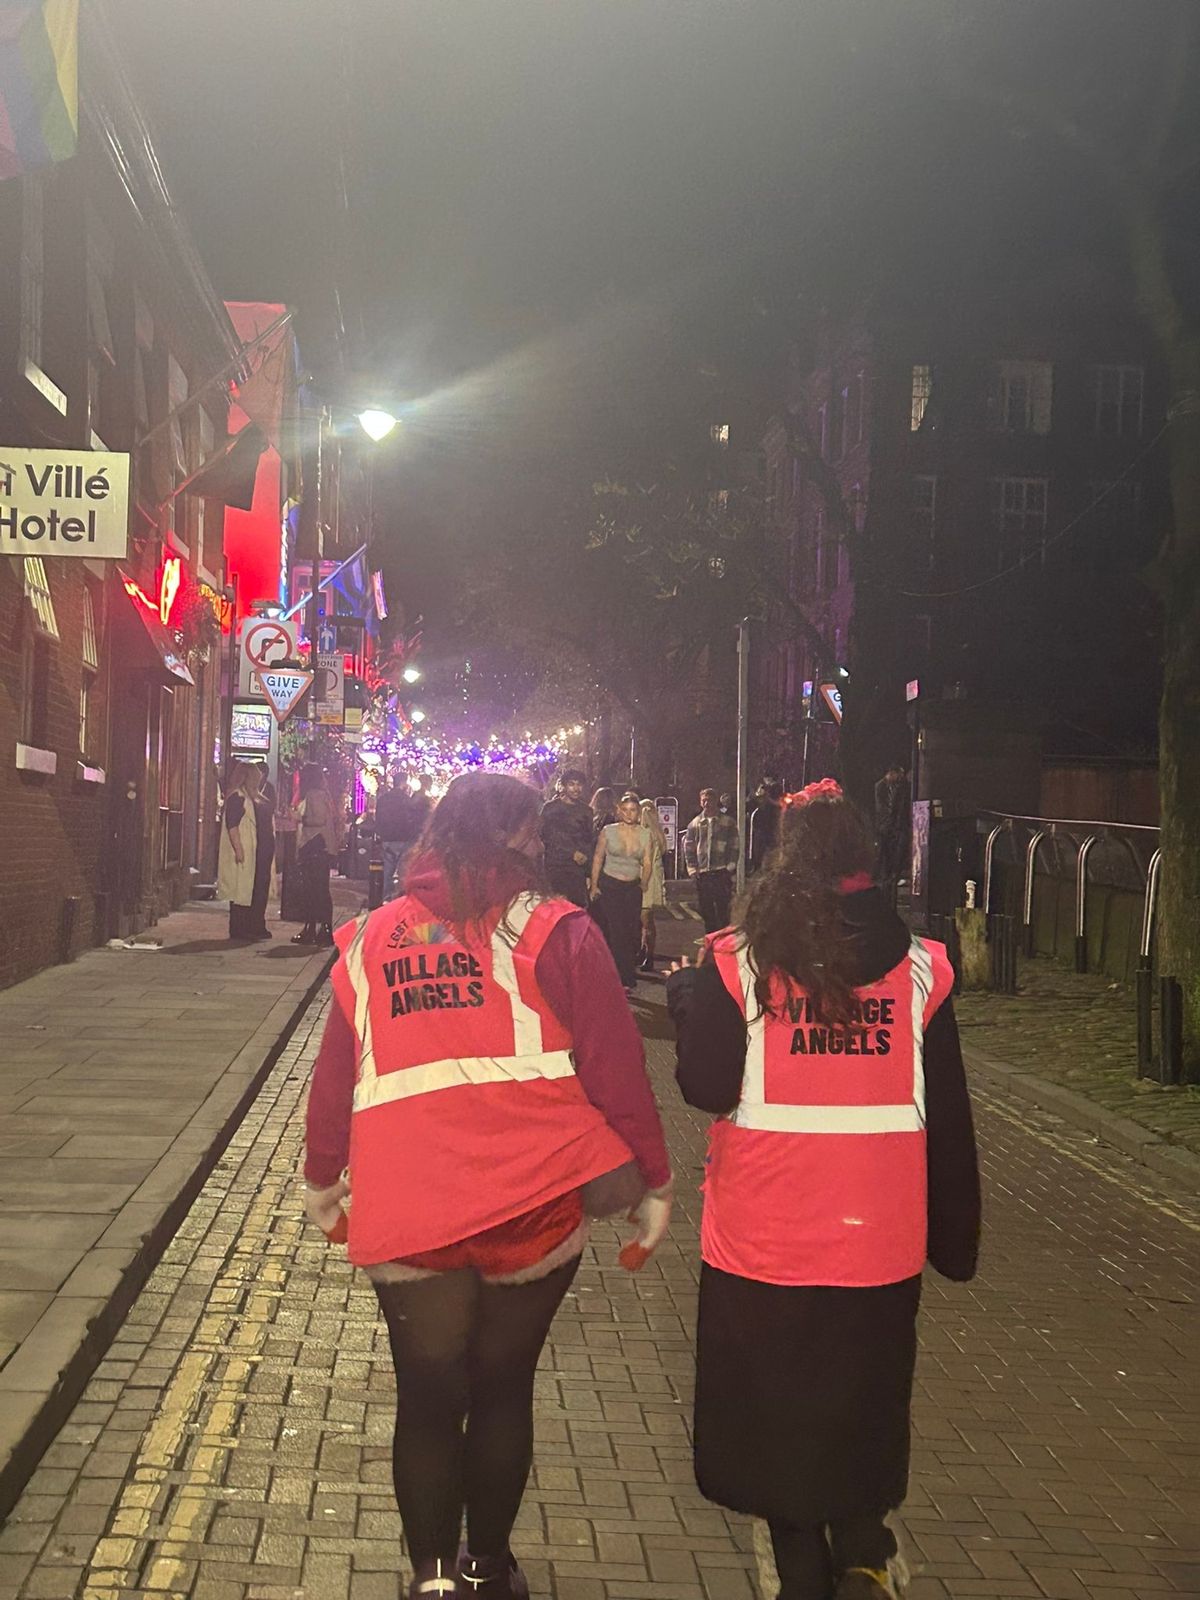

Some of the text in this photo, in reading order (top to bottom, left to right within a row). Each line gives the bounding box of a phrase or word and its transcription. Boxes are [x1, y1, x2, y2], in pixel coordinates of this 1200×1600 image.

[25, 464, 110, 500] Villé
[0, 506, 96, 542] Hotel
[266, 676, 299, 689] GIVE
[271, 689, 293, 698] WAY
[388, 919, 408, 949] LGBT
[382, 951, 483, 988] VILLAGE
[391, 981, 485, 1019] ANGELS
[790, 1027, 892, 1056] ANGELS
